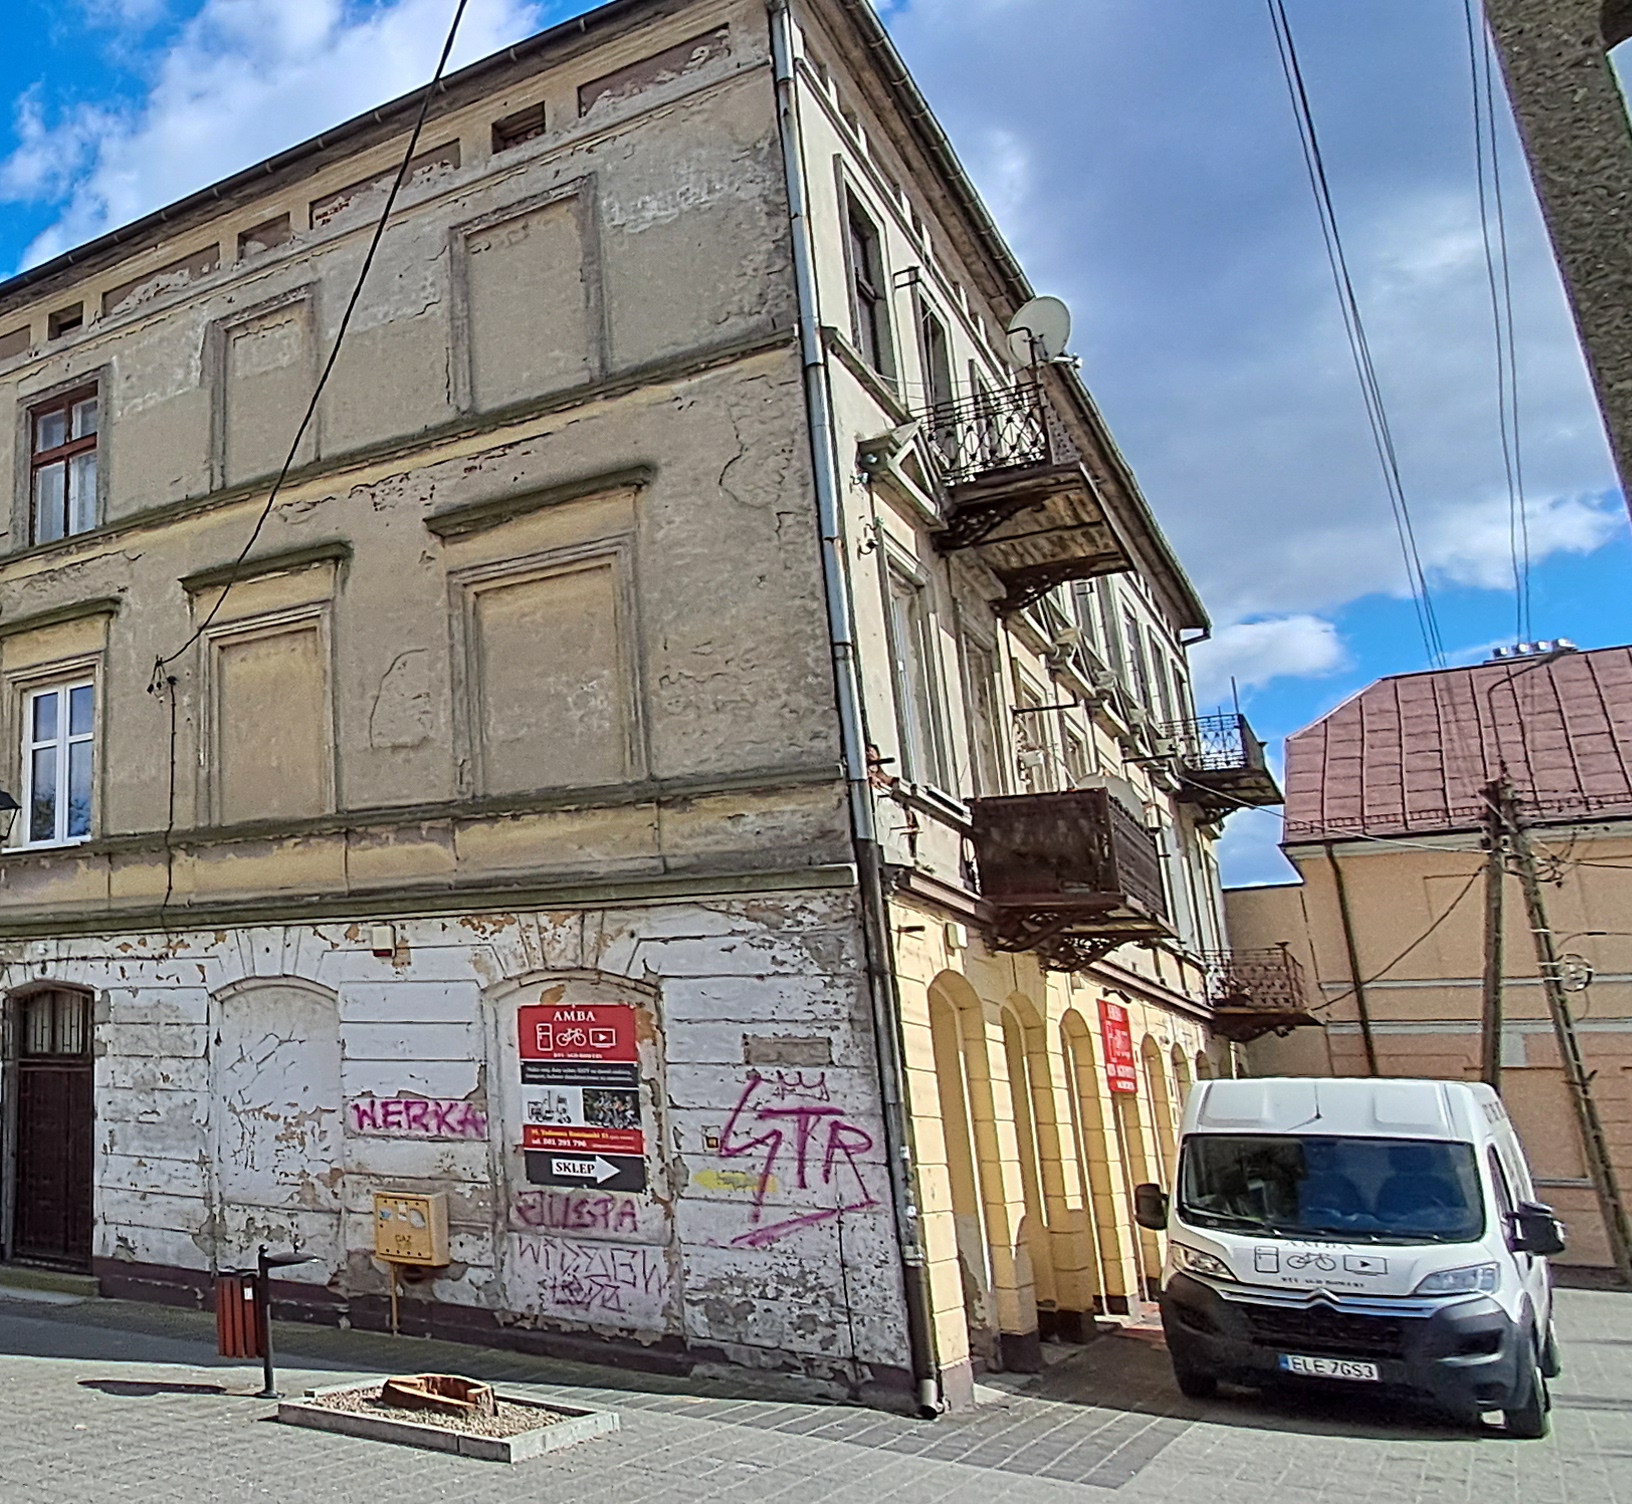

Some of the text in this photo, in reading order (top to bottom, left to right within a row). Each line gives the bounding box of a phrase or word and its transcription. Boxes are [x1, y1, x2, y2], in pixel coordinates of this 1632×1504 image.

[553, 1010, 596, 1022] AMBA
[352, 1099, 488, 1137] WERKA
[555, 1161, 596, 1175] SKLEP
[1291, 1357, 1374, 1379] ELE 7GS3
